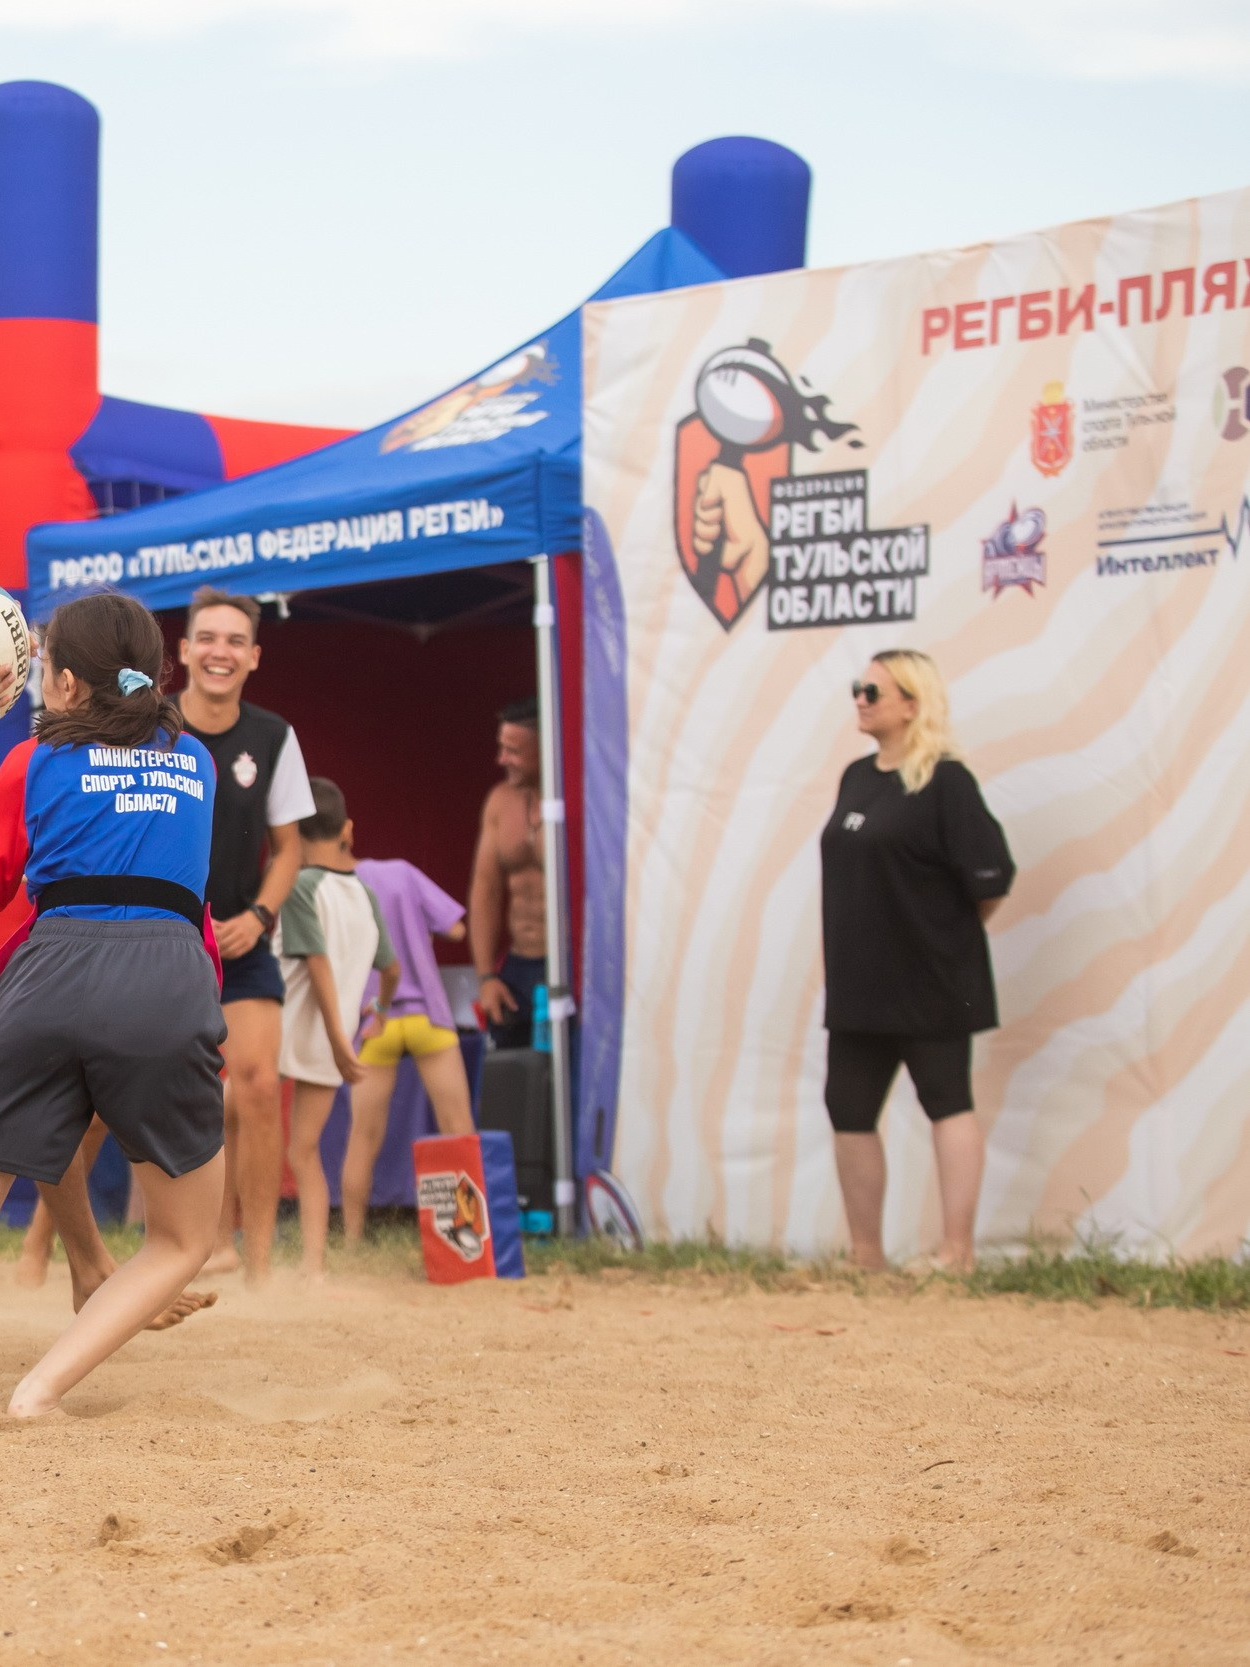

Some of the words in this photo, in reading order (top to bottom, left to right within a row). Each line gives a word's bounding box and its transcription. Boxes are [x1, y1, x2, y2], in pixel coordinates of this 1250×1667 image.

[921, 257, 1250, 357] РЕГБИ-ПЛЯ
[126, 531, 255, 578] «ТУЛЬСКАЯ
[256, 509, 405, 563] ФЕДЕРАЦИЯ
[406, 497, 505, 541] РЕГБИ»
[771, 495, 865, 541] РЕГБИ
[771, 525, 927, 583] ТУЛЬСКОЙ
[1097, 548, 1220, 577] Интеллект
[770, 576, 914, 626] ОБЛАСТИ
[88, 748, 197, 773] МИНИСТЕРСТВО
[81, 774, 137, 793] СПОРТА
[140, 770, 204, 802] ТУЛЬСКОЙ
[115, 793, 178, 814] ОБЛАСТИ
